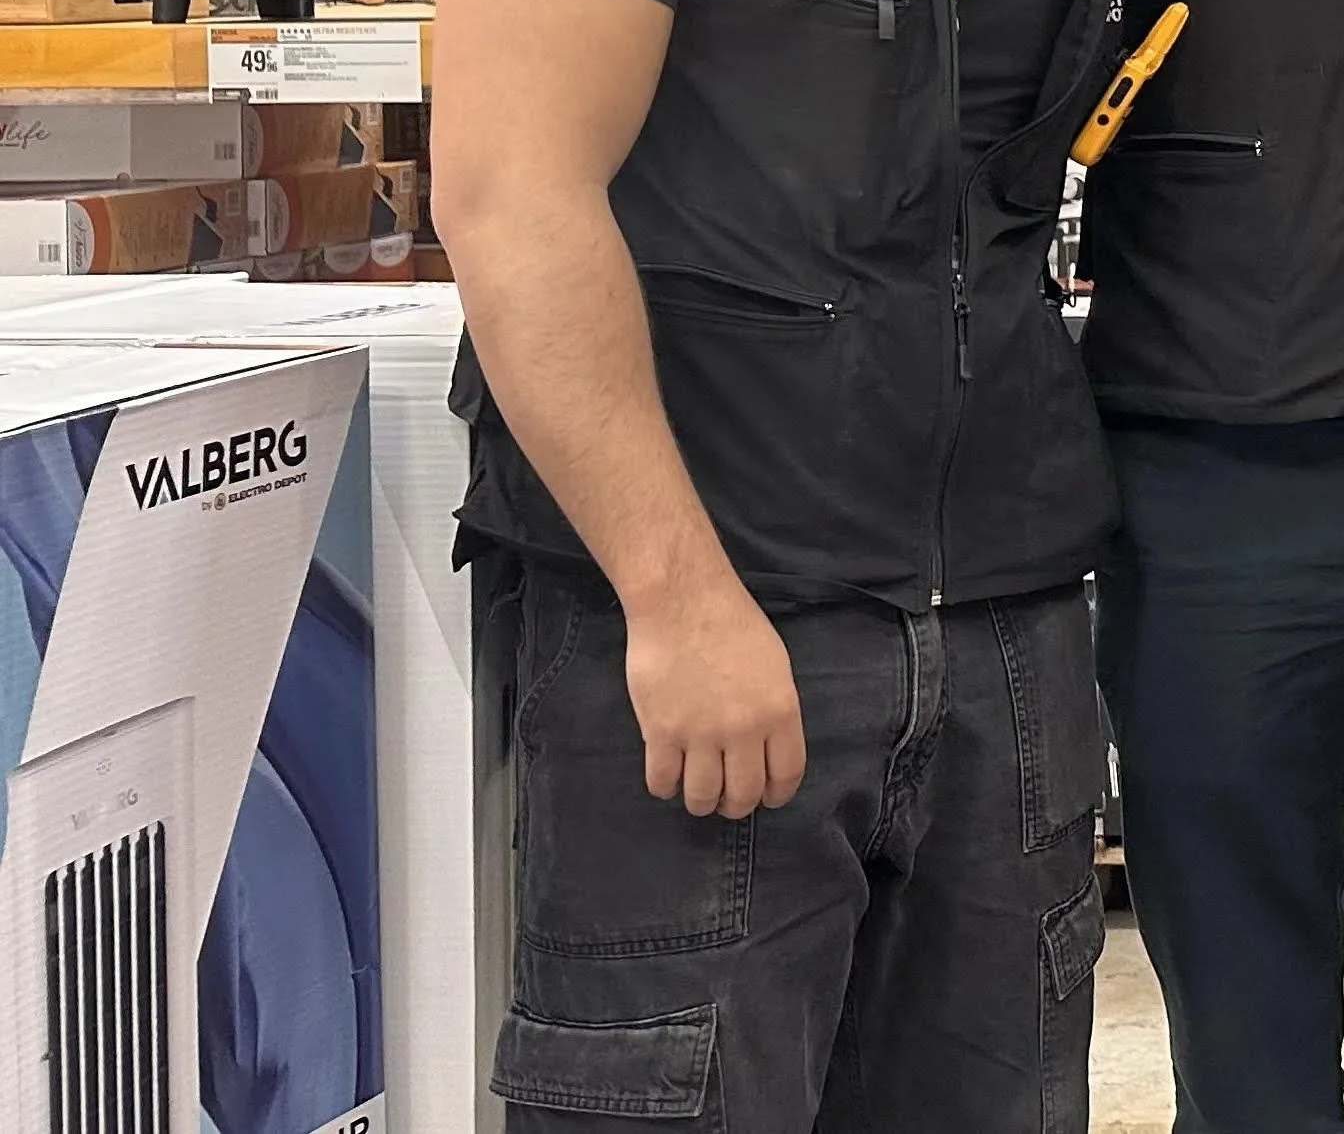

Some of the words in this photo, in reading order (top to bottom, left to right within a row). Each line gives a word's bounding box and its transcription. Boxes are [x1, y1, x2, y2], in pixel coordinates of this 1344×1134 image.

[241, 50, 266, 73] 49
[125, 419, 307, 511] VALBERG
[228, 482, 273, 504] ELECTRO
[273, 472, 308, 490] DEPOT
